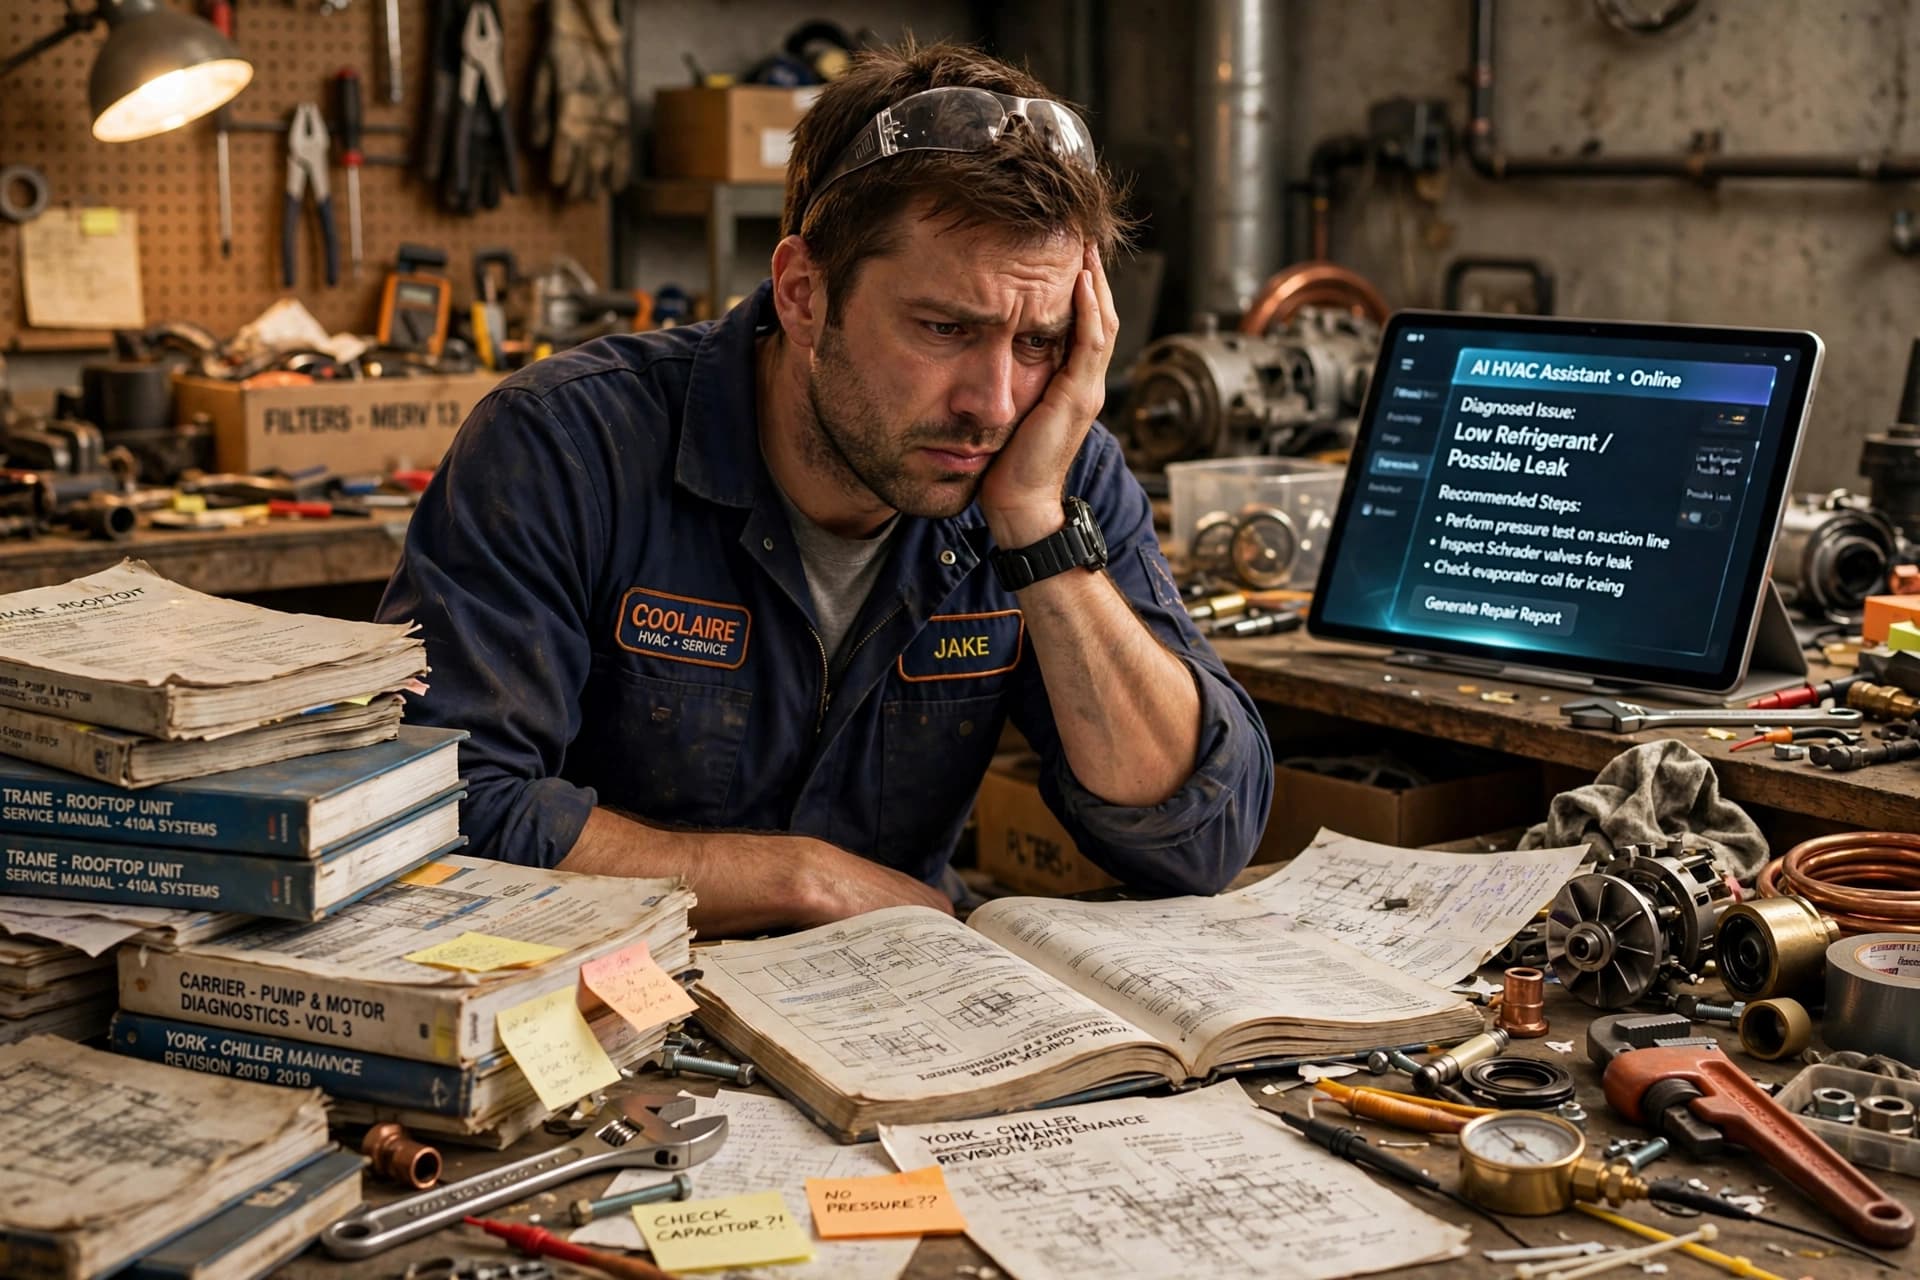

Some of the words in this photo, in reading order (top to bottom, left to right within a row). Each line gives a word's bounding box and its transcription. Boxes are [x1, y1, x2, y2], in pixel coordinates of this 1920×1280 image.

[1471, 360, 1490, 376] AI
[1492, 361, 1539, 379] HVAC
[1539, 364, 1611, 384] Assistant
[1630, 370, 1682, 389] Online
[264, 404, 352, 435] FILTERS
[370, 402, 431, 429] MERV
[1460, 397, 1536, 418] Diagnosed
[1536, 403, 1576, 420] Issue:
[1454, 423, 1493, 443] Low
[1495, 425, 1598, 452] Refrigerant
[1447, 449, 1521, 473] Possible
[1524, 455, 1570, 477] Leak
[1438, 484, 1539, 509] Recommended
[1539, 495, 1582, 515] Steps:
[1445, 513, 1495, 531] Perform
[1495, 520, 1550, 537] pressure
[1552, 525, 1575, 540] test
[1577, 529, 1595, 542] on
[1597, 530, 1644, 547] suction
[1646, 533, 1670, 550] line
[1440, 536, 1485, 554] Inspect
[1486, 541, 1543, 561] Schrader
[1544, 548, 1583, 566] valves
[1585, 551, 1605, 567] for
[1605, 553, 1633, 571] leak
[1434, 559, 1472, 578] Check
[1472, 567, 1540, 585] evaporator
[1541, 573, 1564, 588] coil
[1565, 574, 1586, 590] for
[1586, 576, 1625, 598] iceing
[632, 603, 737, 643] COOLAIRE
[1425, 596, 1479, 616] Generate
[1479, 603, 1519, 621] Repair
[1519, 606, 1562, 626] Report
[638, 630, 671, 648] HVAC
[681, 638, 728, 656] SERVICE
[933, 636, 990, 659] JAKE
[3, 788, 53, 806] TRANE
[66, 794, 136, 813] ROOFTOP
[139, 799, 174, 816] UNIT
[3, 807, 55, 823] SERVICE
[57, 811, 112, 828] MANUAL
[123, 817, 156, 832] 410A
[158, 819, 218, 837] SYSTEMS
[6, 849, 58, 868] TRANE
[72, 855, 144, 875] ROOFTOP
[148, 861, 184, 879] UNIT
[5, 868, 58, 885] SERVICE
[61, 873, 115, 890] MANUAL
[126, 879, 158, 894] 410A
[160, 881, 220, 899] SYSTEMS
[179, 971, 246, 998] CARRIER
[260, 984, 305, 1008] PUMP
[310, 993, 321, 1010] &
[326, 995, 385, 1021] MOTOR
[180, 993, 290, 1027] DIAGNOSTICS
[305, 1013, 338, 1035] VOL
[343, 1020, 353, 1037] 3
[165, 1030, 207, 1052] YORK
[220, 1039, 284, 1065] CHILLER
[164, 1050, 231, 1075] REVISION
[235, 1062, 270, 1080] 2019
[276, 1069, 312, 1087] 2019
[919, 1129, 980, 1145] YORK
[997, 1115, 1080, 1135] CHILLER
[1014, 1115, 1150, 1142] MAINTENANCE
[936, 1143, 1026, 1165] REVISION
[1029, 1137, 1073, 1151] 2019
[825, 1190, 852, 1200] NO
[826, 1195, 938, 1214] PRESSURE??
[654, 1208, 731, 1227] CHECK
